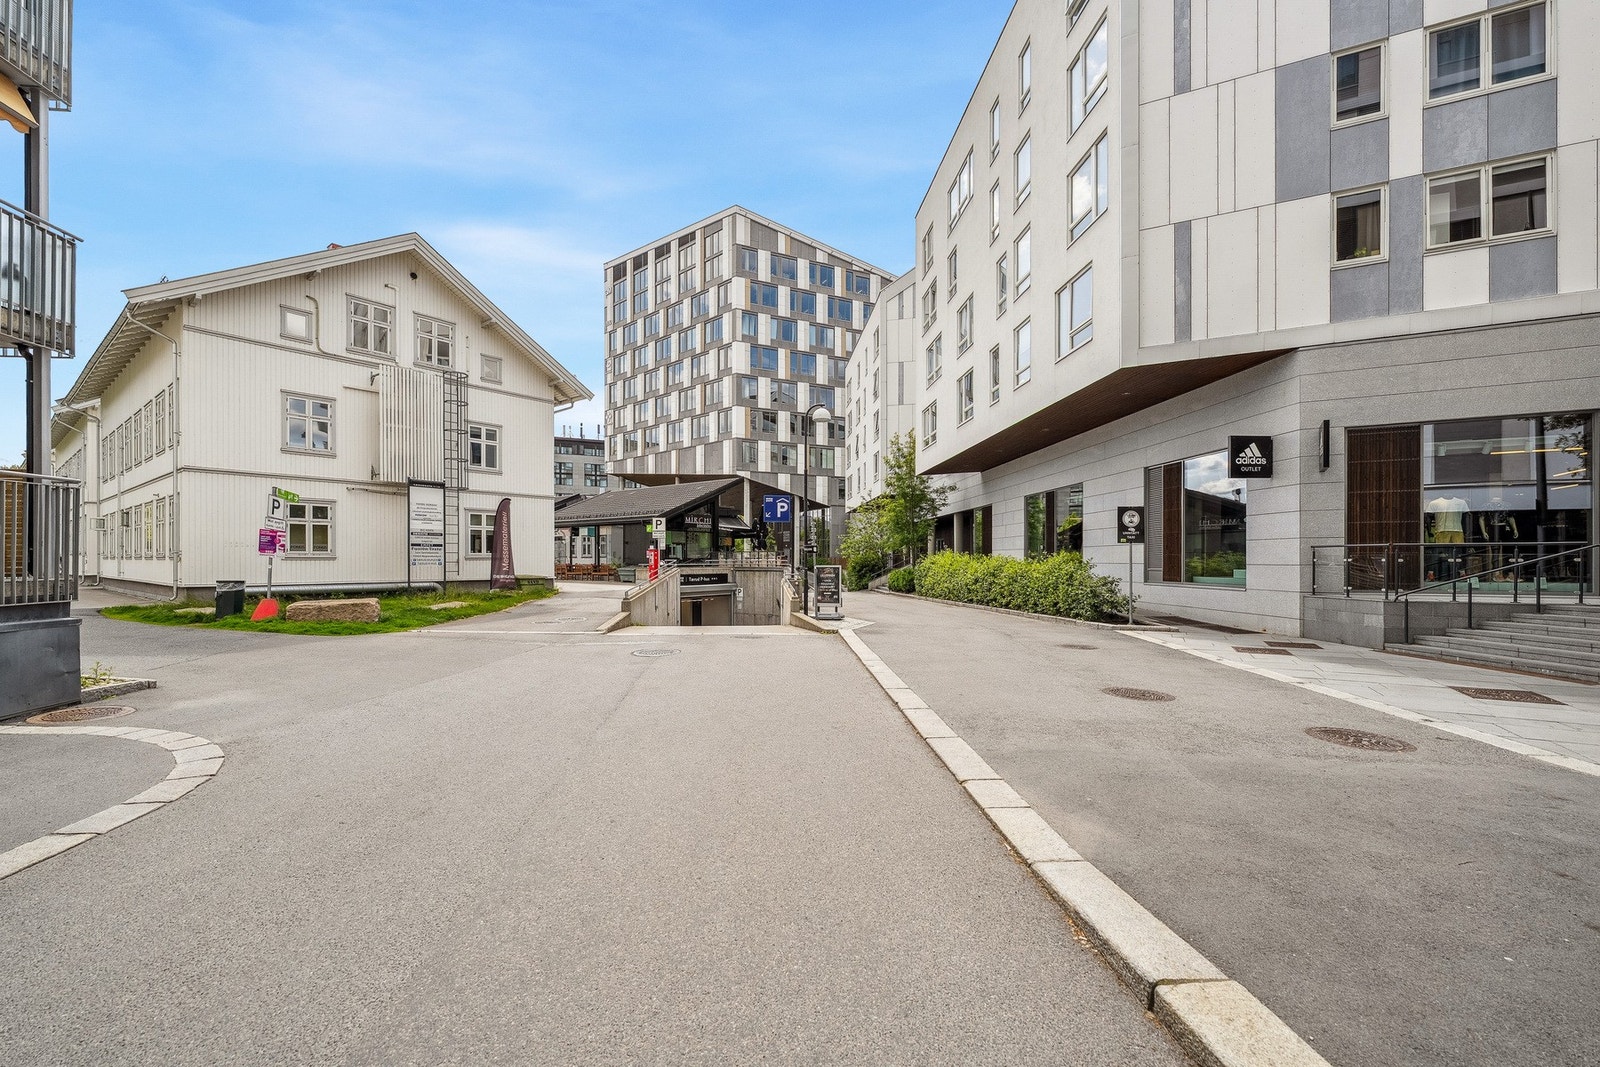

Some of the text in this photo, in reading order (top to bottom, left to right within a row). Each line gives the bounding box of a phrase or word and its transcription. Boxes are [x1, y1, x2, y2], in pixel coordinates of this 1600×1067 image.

[1235, 456, 1267, 465] adidas
[271, 498, 281, 515] P
[777, 502, 788, 518] P
[655, 519, 663, 530] P
